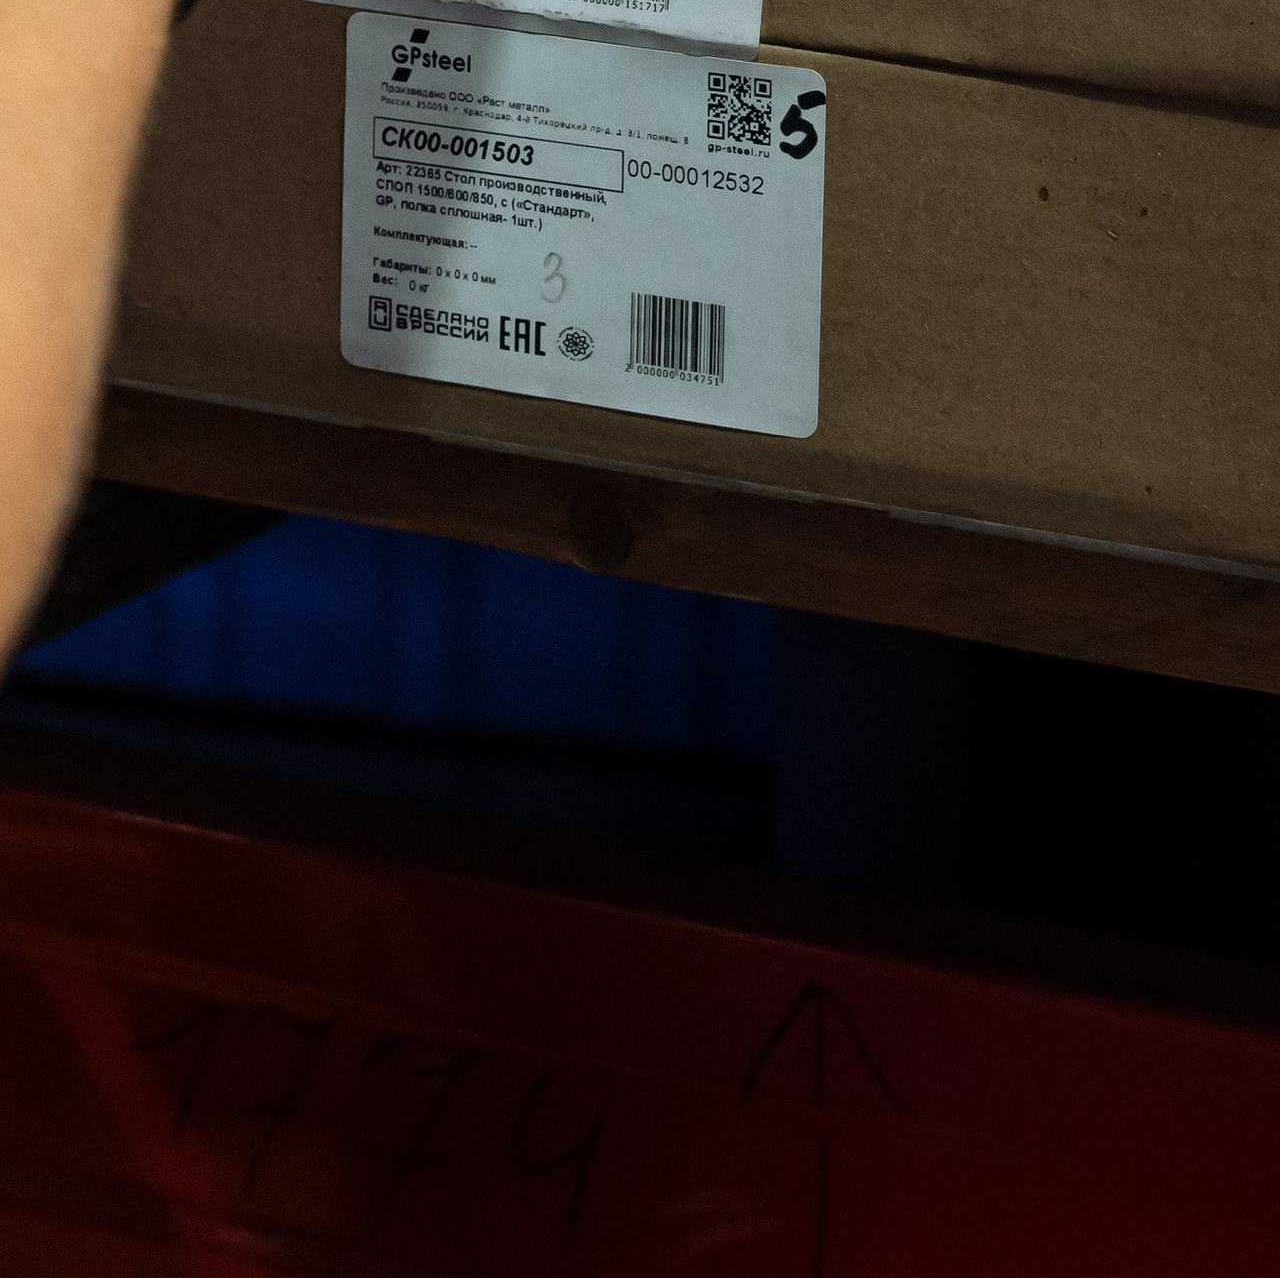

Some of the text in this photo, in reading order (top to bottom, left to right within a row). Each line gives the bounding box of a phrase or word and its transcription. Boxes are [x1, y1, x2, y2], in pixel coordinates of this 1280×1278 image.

[390, 44, 472, 73] GPsteel
[779, 90, 826, 160] 5
[707, 143, 770, 159] gp-steel.ru
[375, 160, 608, 206] Арт: 22365 Стол производственный,
[375, 178, 414, 194] СПОП
[627, 158, 763, 195] 00-00012532
[373, 226, 468, 249] Комплектующая:
[372, 256, 432, 275] Габариты:
[541, 252, 568, 303] 3
[395, 303, 490, 330] СДЕЛАНО
